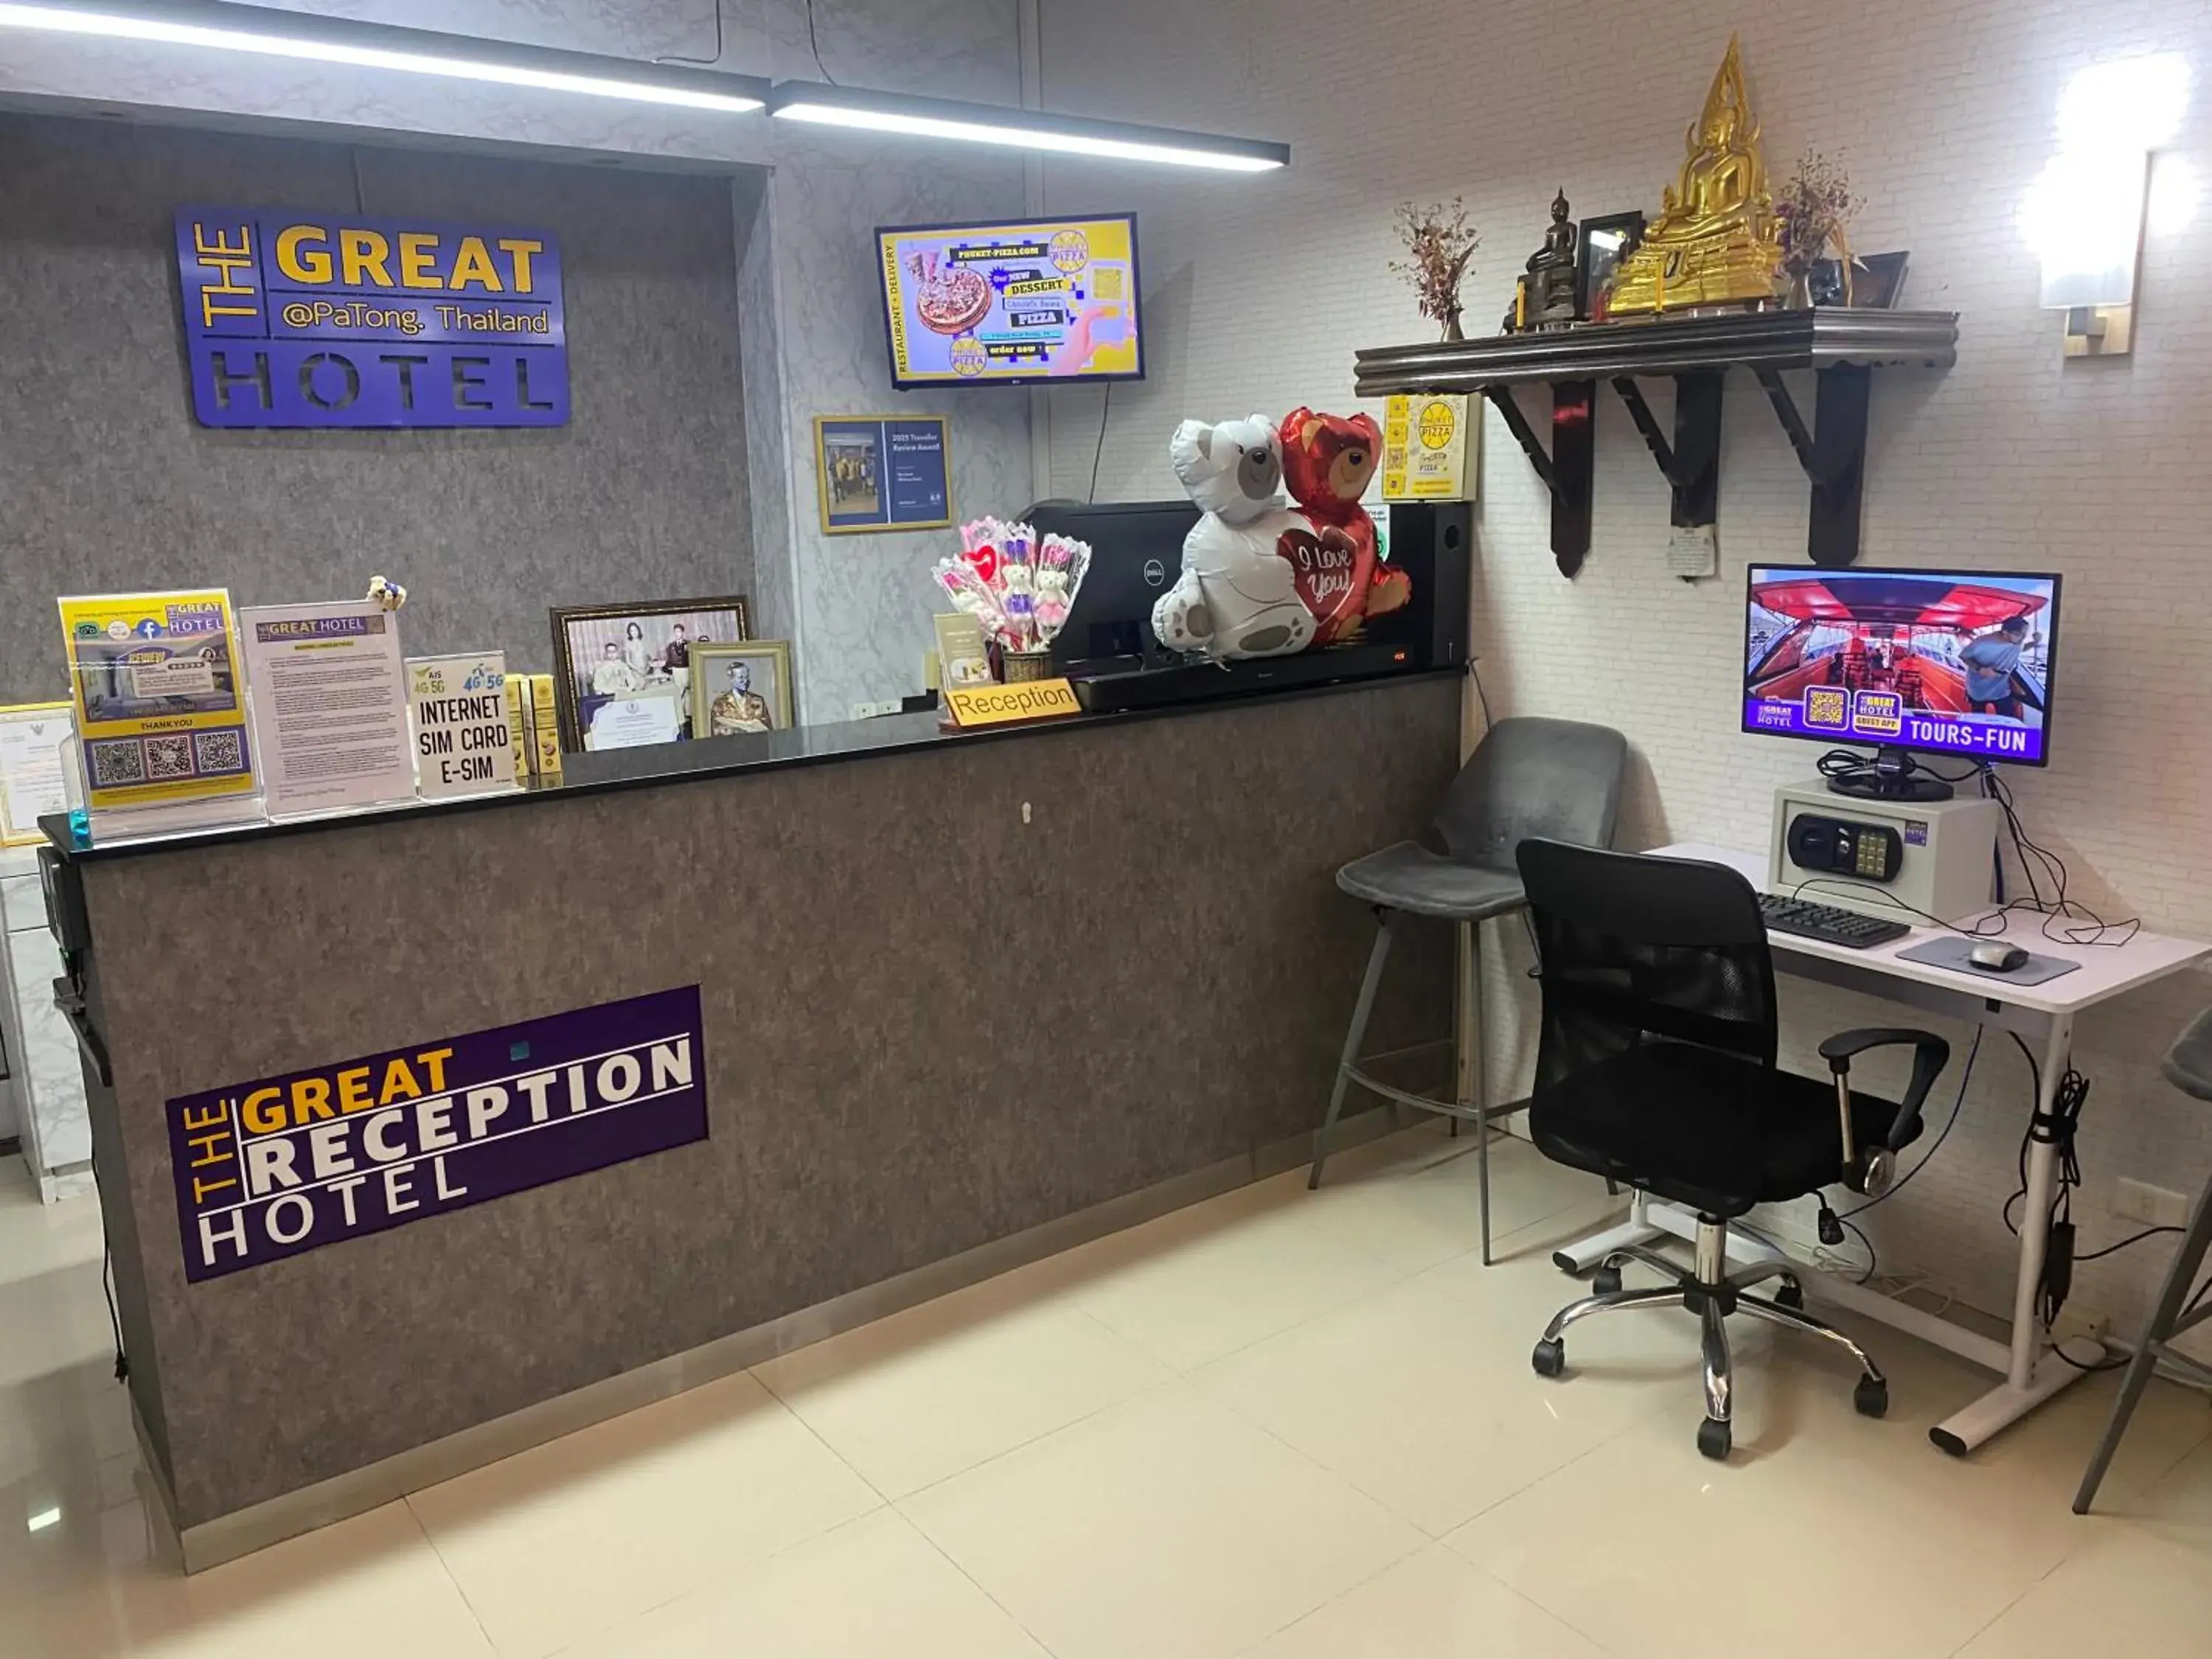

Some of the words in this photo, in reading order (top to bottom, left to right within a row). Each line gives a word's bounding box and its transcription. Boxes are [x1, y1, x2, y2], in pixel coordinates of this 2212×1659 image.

[275, 224, 543, 293] GREAT
[886, 246, 897, 293] DELIVERY
[195, 223, 257, 327] THE
[1012, 279, 1064, 295] DESSERT
[435, 305, 547, 333] Thailand
[1018, 311, 1057, 325] PIZZA
[891, 305, 906, 372] RESTAURANT
[211, 351, 554, 411] HOTEL
[1422, 427, 1450, 437] PIZZA
[1298, 546, 1312, 571] I
[1315, 546, 1352, 568] Love
[178, 602, 220, 613] GREAT
[170, 618, 224, 633] HOTEL
[270, 622, 318, 634] GREAT
[320, 618, 365, 631] HOTEL
[420, 694, 501, 726] INTERNET
[953, 686, 1074, 716] Reception
[1860, 706, 1896, 717] HOTEL
[141, 720, 173, 730] THANK
[1758, 716, 1792, 728] HOTEL
[1911, 720, 2026, 752] TOURS-FUN
[420, 729, 453, 756] SIM
[461, 724, 508, 751] CARD
[441, 756, 494, 785] E-SIM
[242, 1047, 453, 1134] GREAT
[247, 1037, 693, 1196] RECEPTION
[183, 1098, 237, 1204] THE
[198, 1155, 467, 1266] HOTEL
